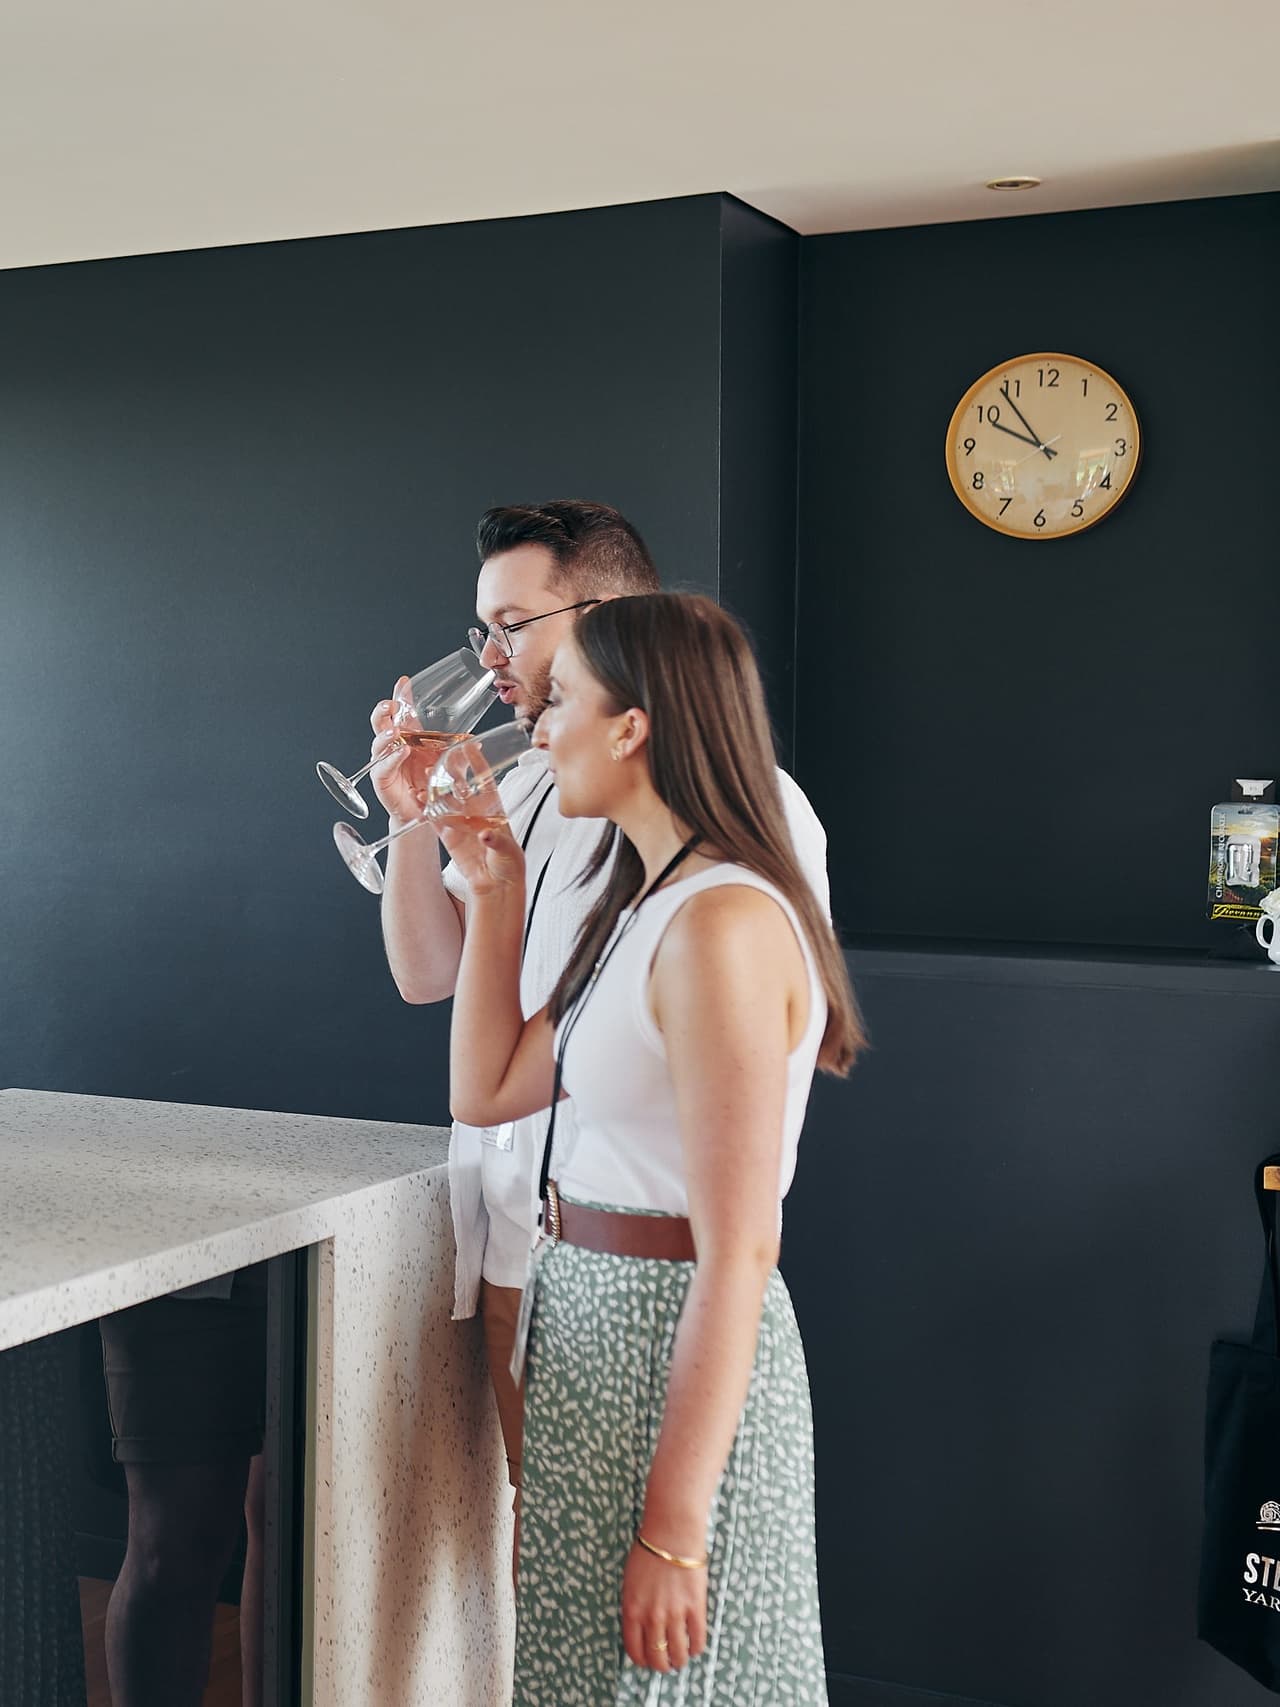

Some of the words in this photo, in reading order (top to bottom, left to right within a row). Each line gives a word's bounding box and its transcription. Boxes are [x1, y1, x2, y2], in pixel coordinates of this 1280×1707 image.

[1037, 368, 1060, 388] 12
[1081, 378, 1089, 398] 1
[1002, 379, 1021, 399] 11
[976, 404, 1001, 424] 10
[1104, 402, 1118, 422] 2
[963, 437, 977, 457] 9
[1114, 438, 1127, 458] 3
[972, 471, 985, 491] 8
[1099, 472, 1112, 491] 4
[998, 497, 1013, 517] 7
[1070, 499, 1085, 519] 5
[1033, 508, 1047, 528] 6
